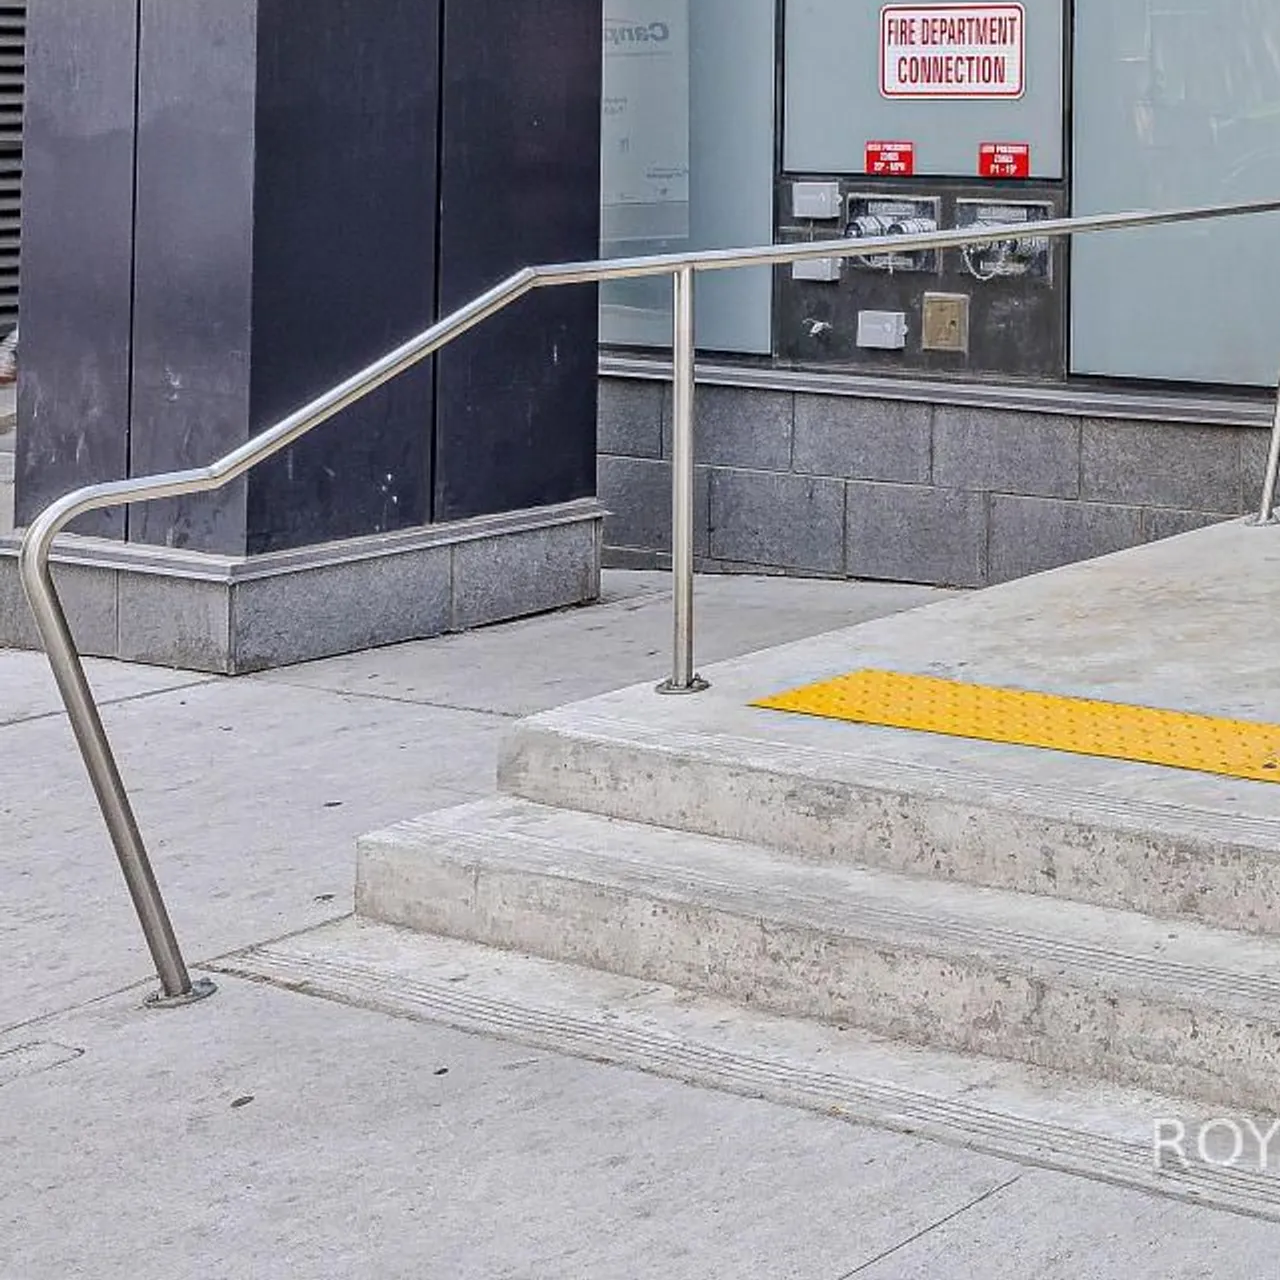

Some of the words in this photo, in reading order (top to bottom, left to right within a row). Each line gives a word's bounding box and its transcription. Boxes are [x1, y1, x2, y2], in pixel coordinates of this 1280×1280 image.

[887, 18, 916, 46] FIRE
[921, 17, 1017, 46] DEPARTMENT
[898, 55, 1006, 84] CONNECTION
